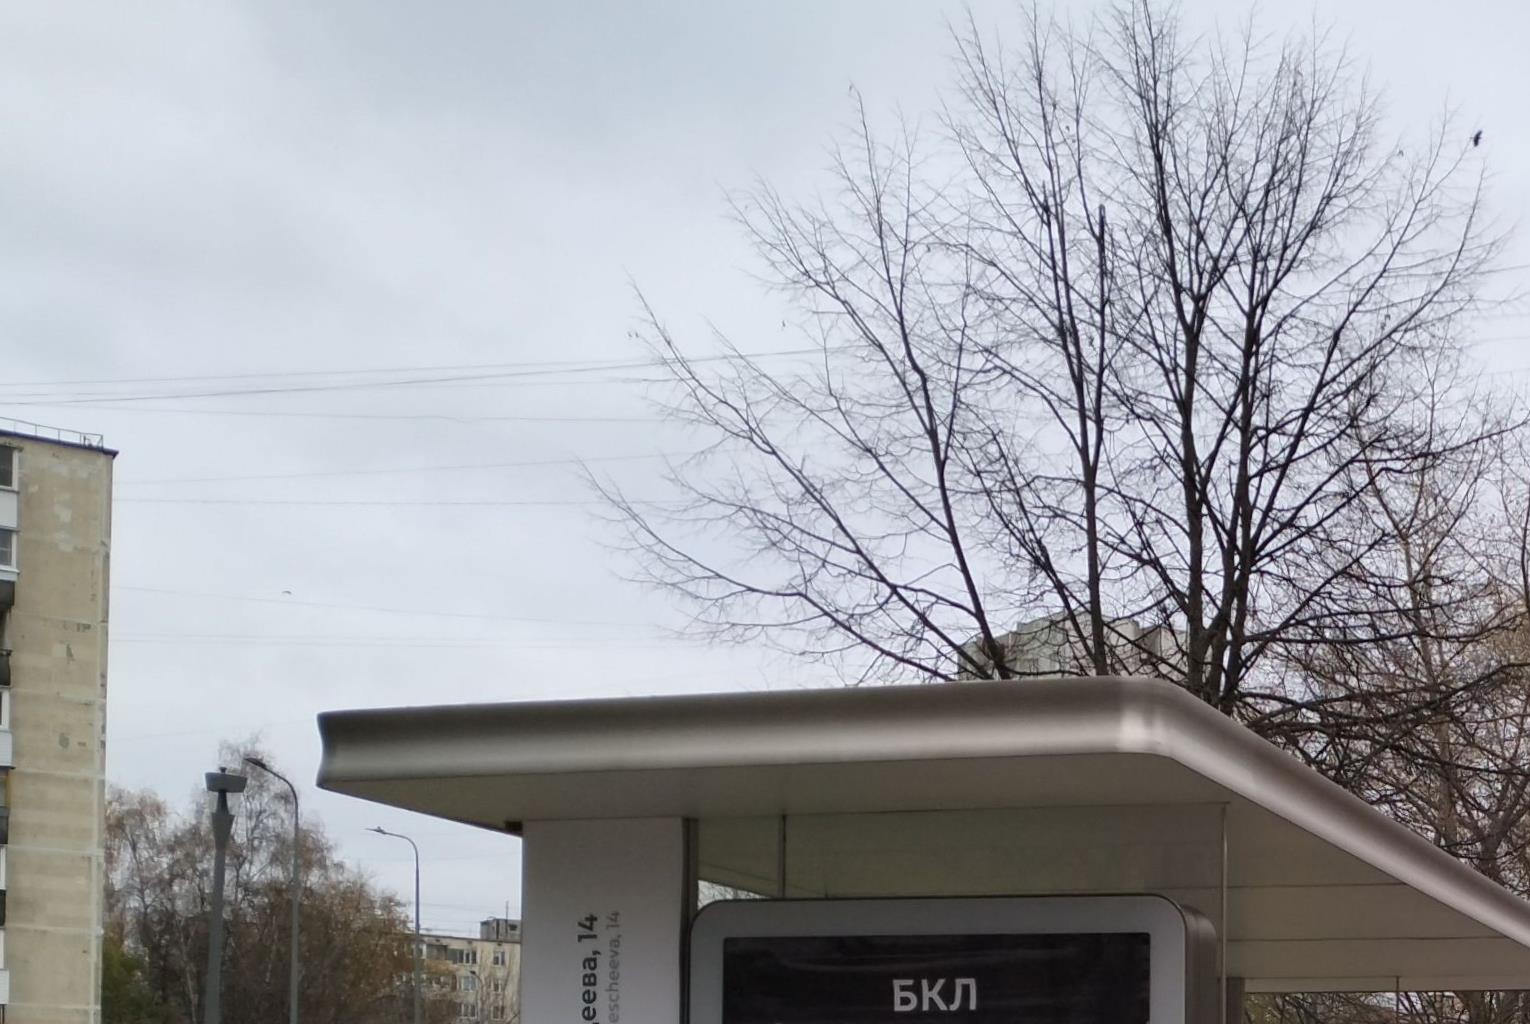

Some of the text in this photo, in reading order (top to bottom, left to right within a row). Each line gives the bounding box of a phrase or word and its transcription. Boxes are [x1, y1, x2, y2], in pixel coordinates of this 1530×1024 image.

[577, 914, 598, 943] 14
[605, 910, 621, 930] 14
[892, 977, 978, 1012] БКЛ
